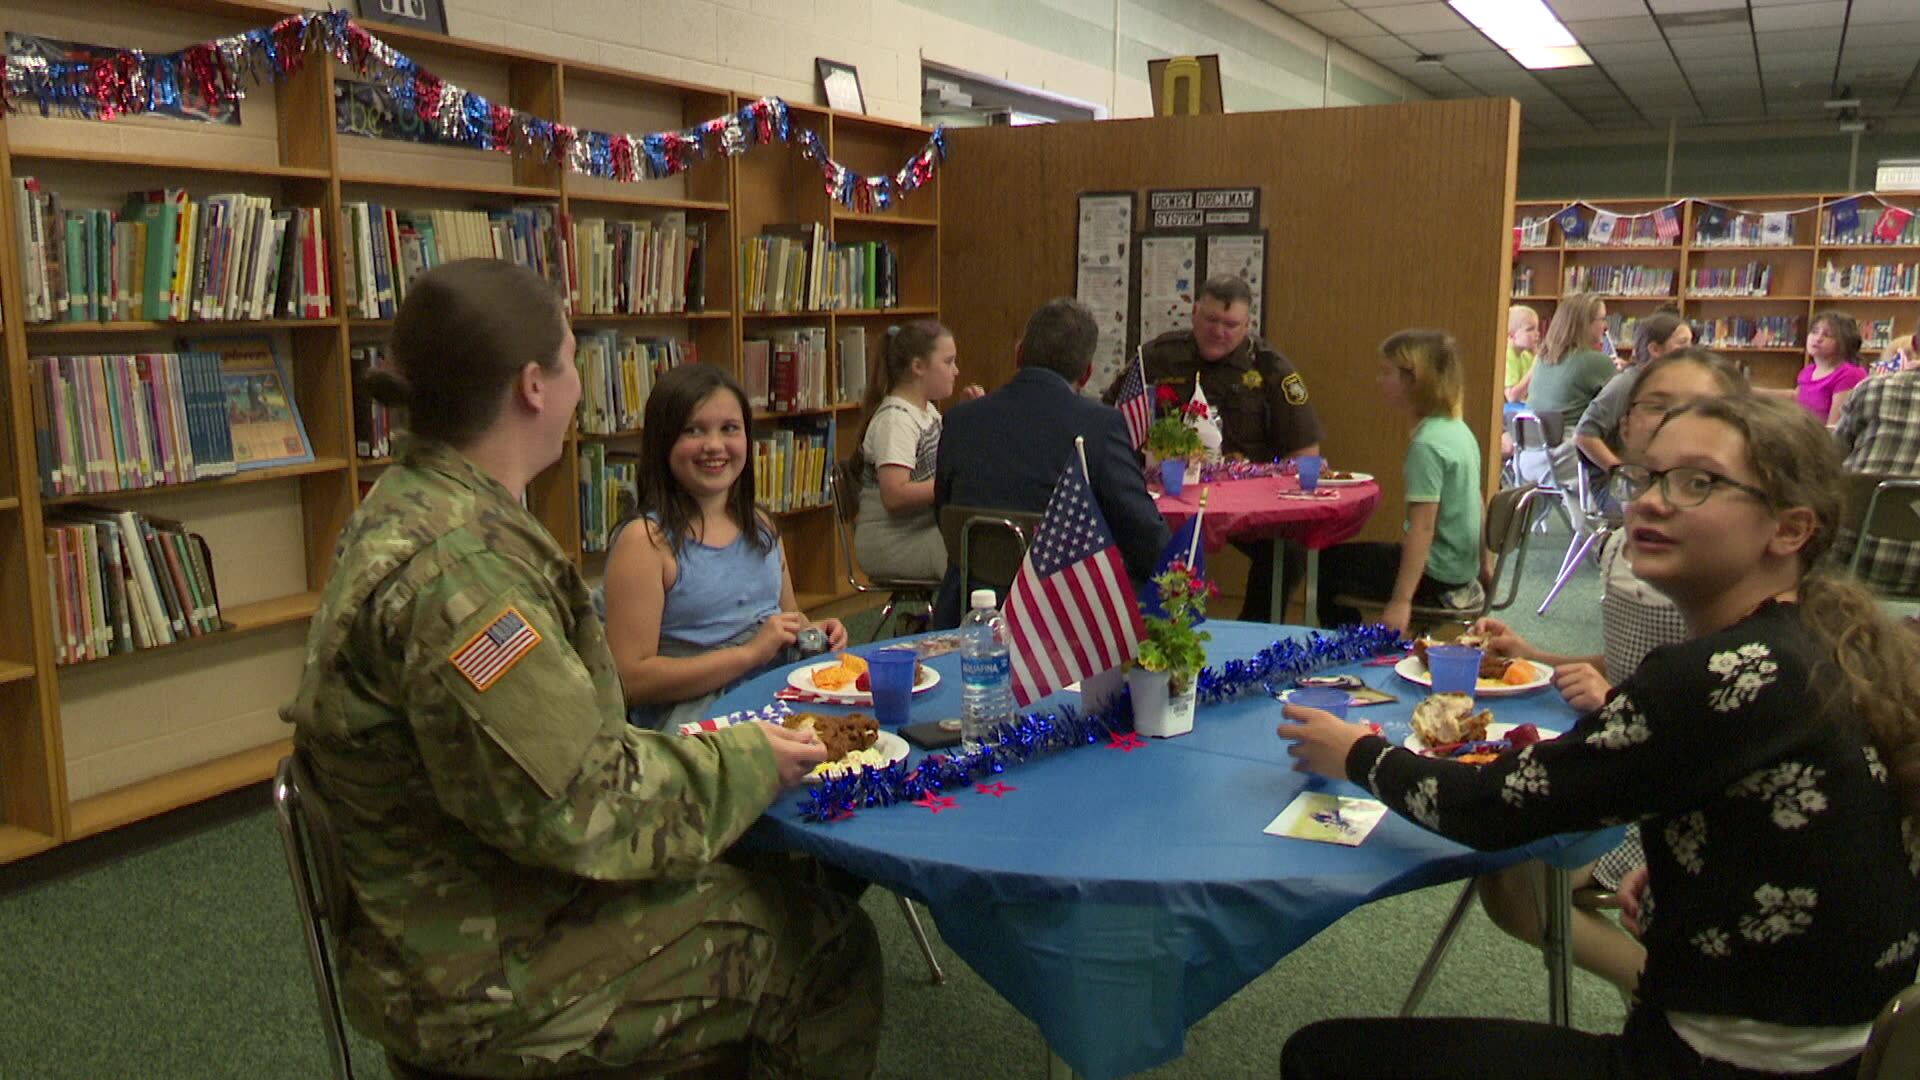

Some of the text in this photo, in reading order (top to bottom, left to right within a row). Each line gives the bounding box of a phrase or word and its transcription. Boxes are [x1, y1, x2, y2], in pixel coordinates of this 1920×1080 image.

[1153, 192, 1252, 208] DEWEY DECIMAL
[1156, 212, 1202, 225] SYSTEM
